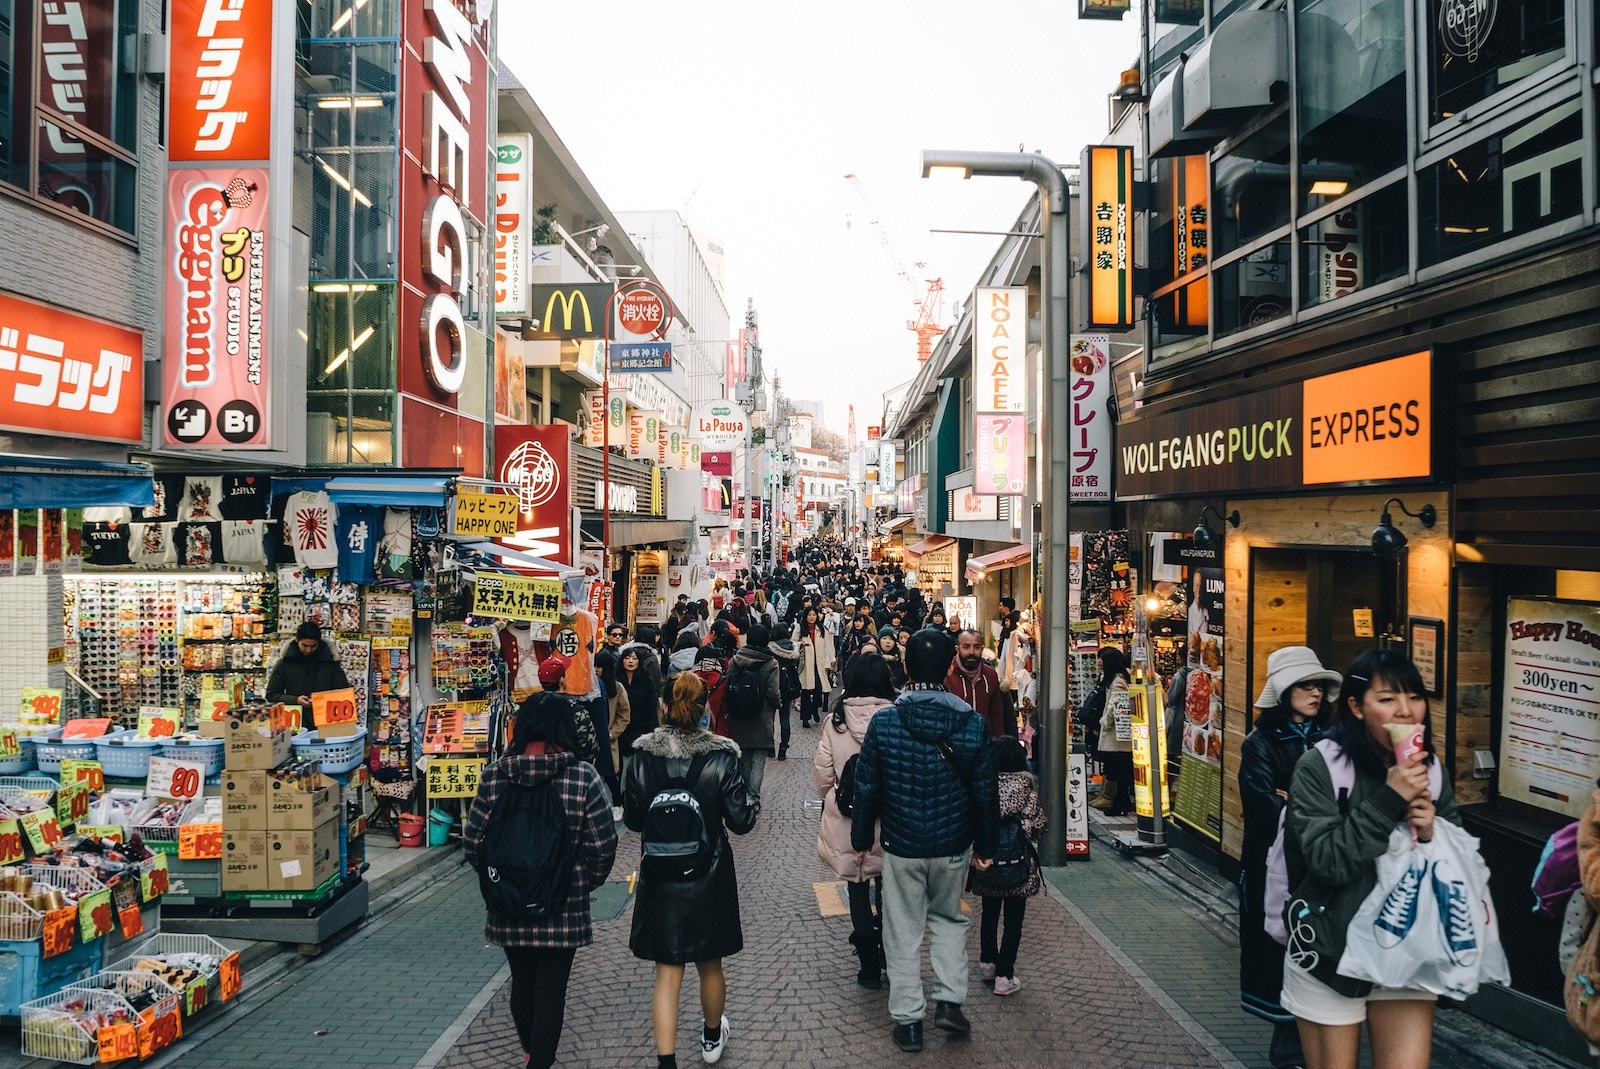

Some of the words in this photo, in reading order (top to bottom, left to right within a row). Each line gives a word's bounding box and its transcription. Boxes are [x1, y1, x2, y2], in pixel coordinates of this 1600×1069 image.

[194, 0, 248, 151] ドラッグ
[1096, 201, 1113, 270] 吉野家
[1117, 202, 1127, 270] YOSHINOYA
[221, 227, 250, 283] プリ
[248, 229, 265, 385] ENTERTAINMENT
[622, 303, 661, 322] 消火栓
[991, 293, 1011, 338] NOA
[226, 285, 241, 356] STUDIO
[621, 347, 660, 358] 東郷神社
[991, 346, 1010, 409] CAFE
[224, 409, 254, 434] B1
[699, 418, 711, 432] La
[713, 418, 744, 433] Pausa
[1072, 377, 1098, 473] クレープ
[1310, 400, 1419, 448] EXPRESS
[979, 419, 989, 472] PURIKURA
[991, 418, 1012, 491] プリクラ
[1122, 429, 1225, 475] WOLFGANG
[1228, 417, 1293, 463] PUCK
[230, 486, 257, 496] JAPAN
[1071, 475, 1098, 487] 原宿
[458, 498, 517, 515] ハッピーワン
[348, 521, 369, 554] 侍
[456, 517, 490, 533] HAPPY
[493, 519, 515, 535] ONE
[476, 604, 513, 614] CARVING
[477, 587, 559, 612] 文字入れ無料
[557, 632, 577, 654] 悟
[1509, 620, 1564, 642] Happy
[1528, 650, 1542, 660] Beer
[326, 700, 354, 723] 100
[169, 767, 199, 797] 80
[429, 764, 477, 775] 無料で
[429, 774, 477, 784] お名前
[429, 784, 477, 793] 彫ります
